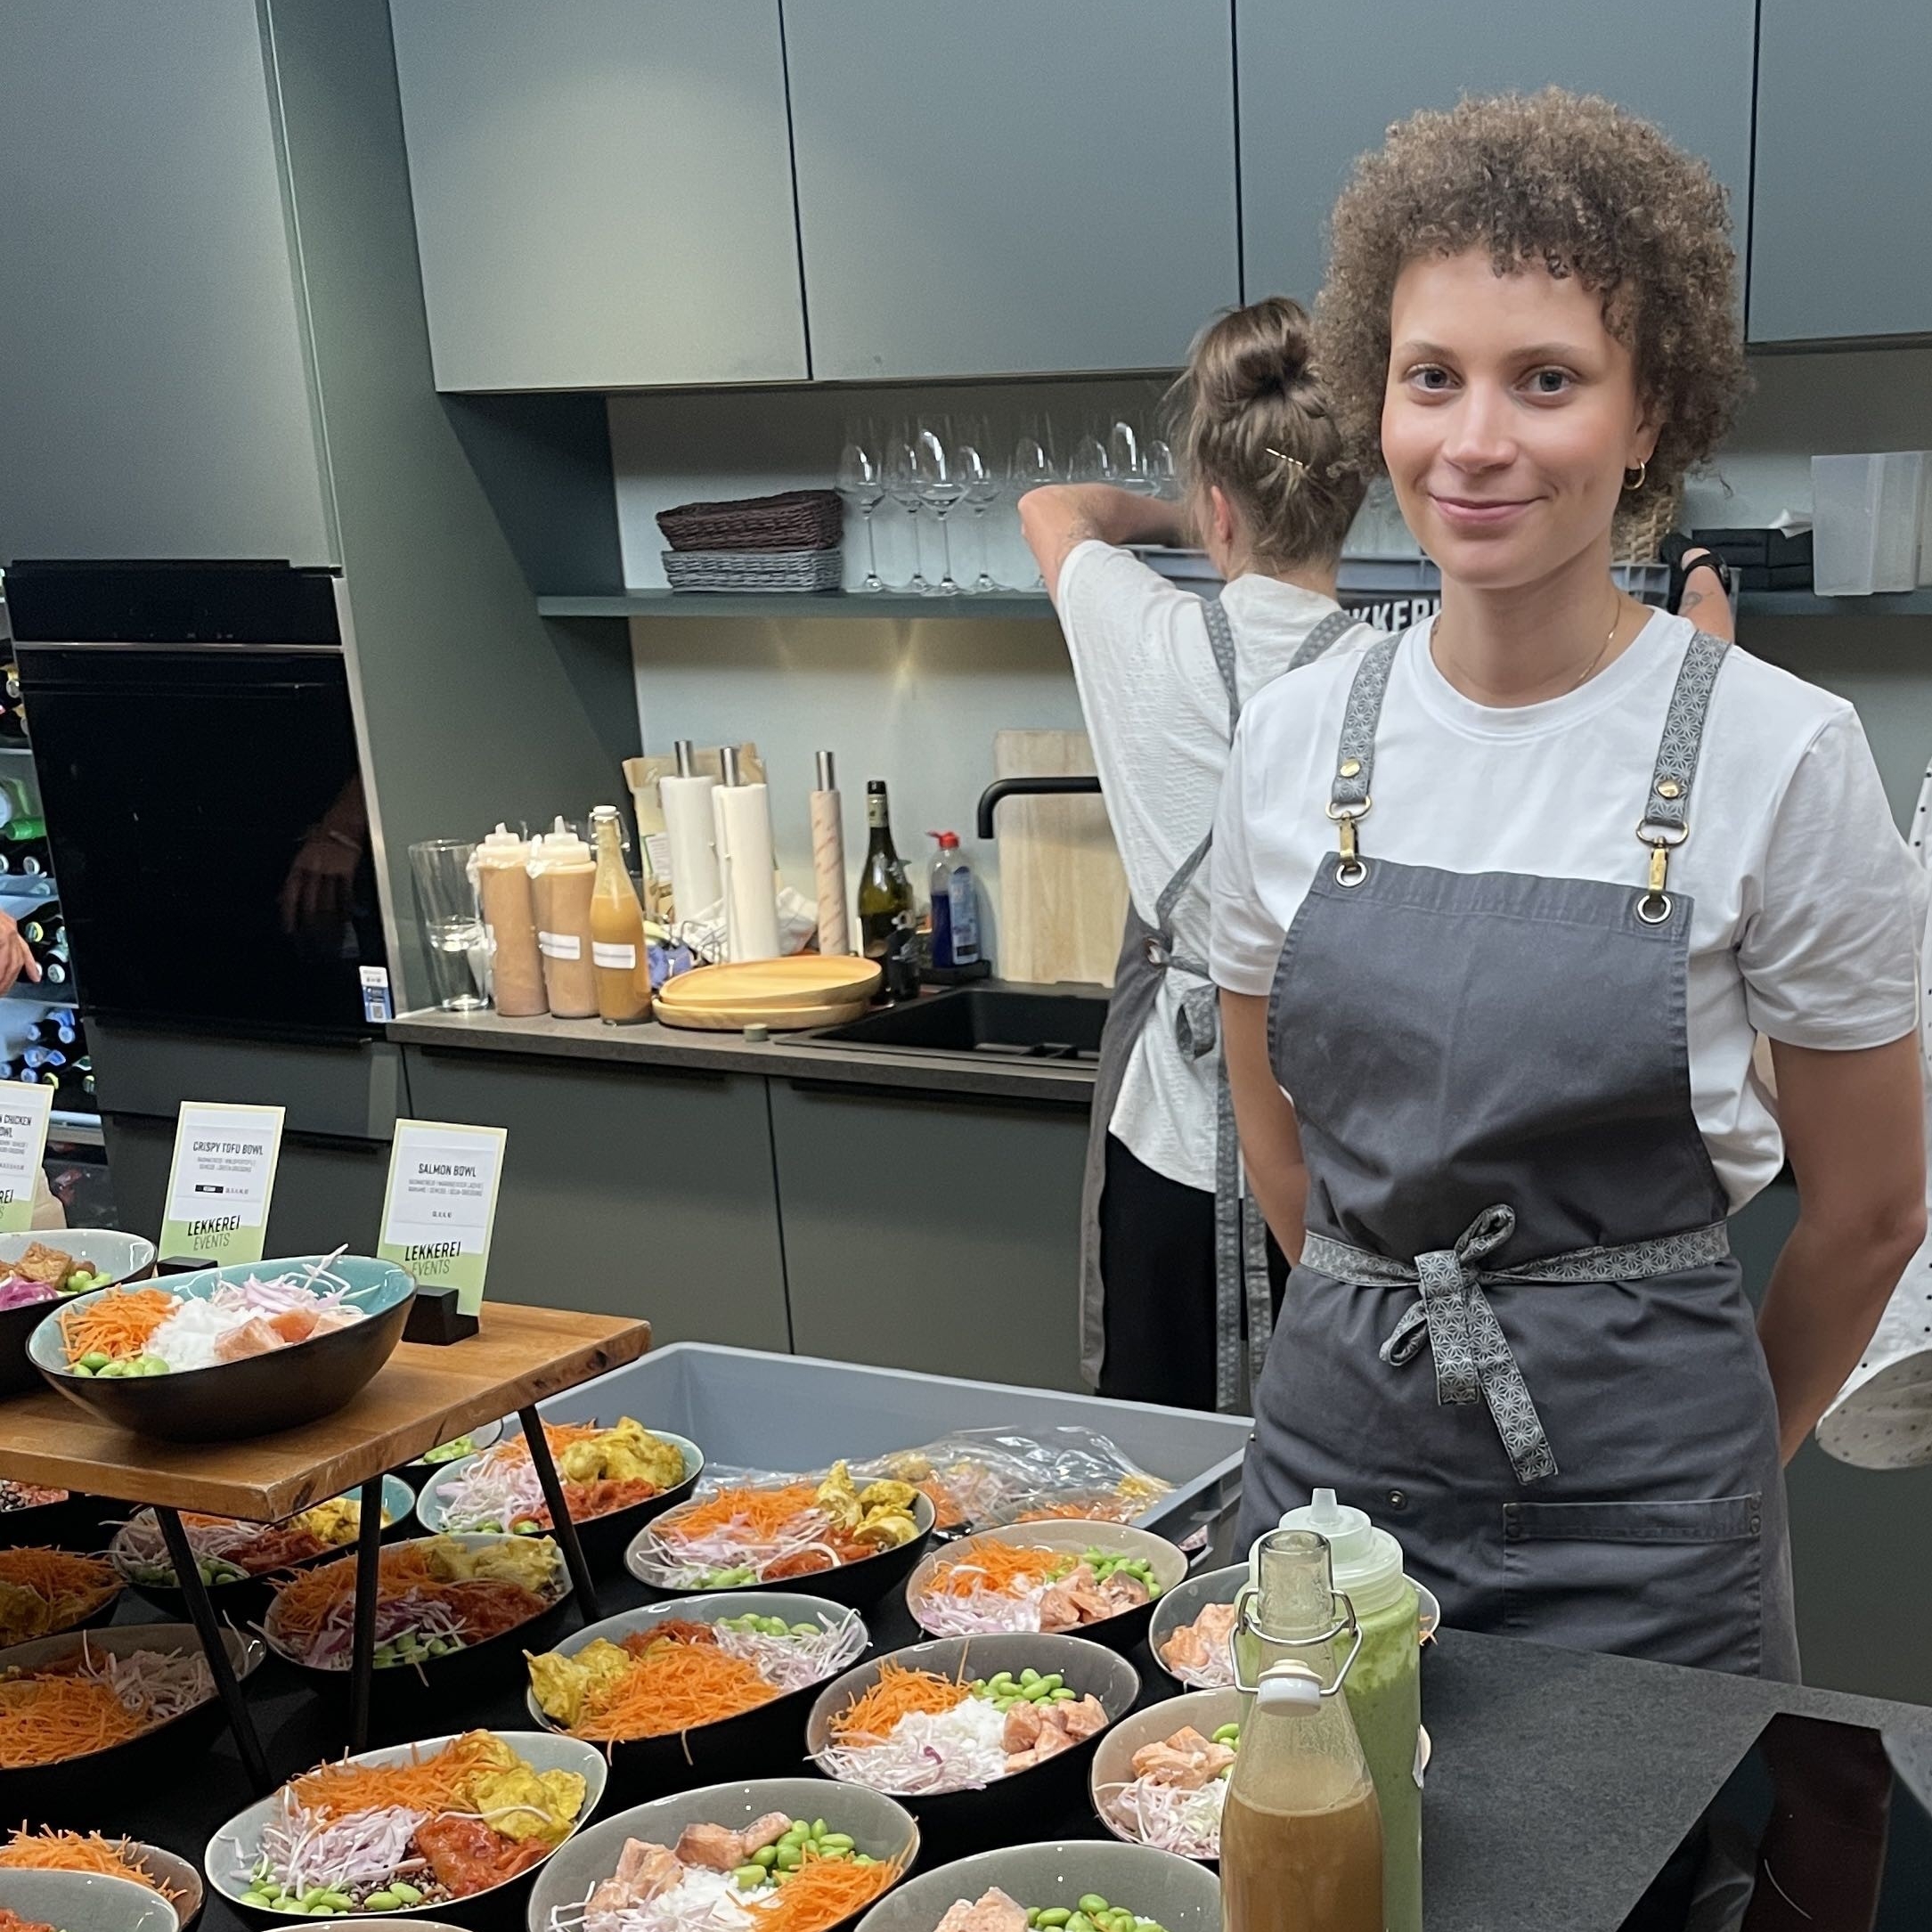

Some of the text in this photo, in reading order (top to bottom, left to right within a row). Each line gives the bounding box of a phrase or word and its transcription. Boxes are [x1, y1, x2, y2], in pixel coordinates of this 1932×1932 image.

[4, 1113, 32, 1126] CHICKEN
[192, 1141, 264, 1156] CRISPY TOFU BOWL
[418, 1162, 477, 1178] SALMON BOWL
[187, 1214, 241, 1236] LEKKEREI
[193, 1232, 231, 1251] EVENTS
[404, 1241, 461, 1262] LEKKEREI
[412, 1259, 451, 1276] EVENTS
